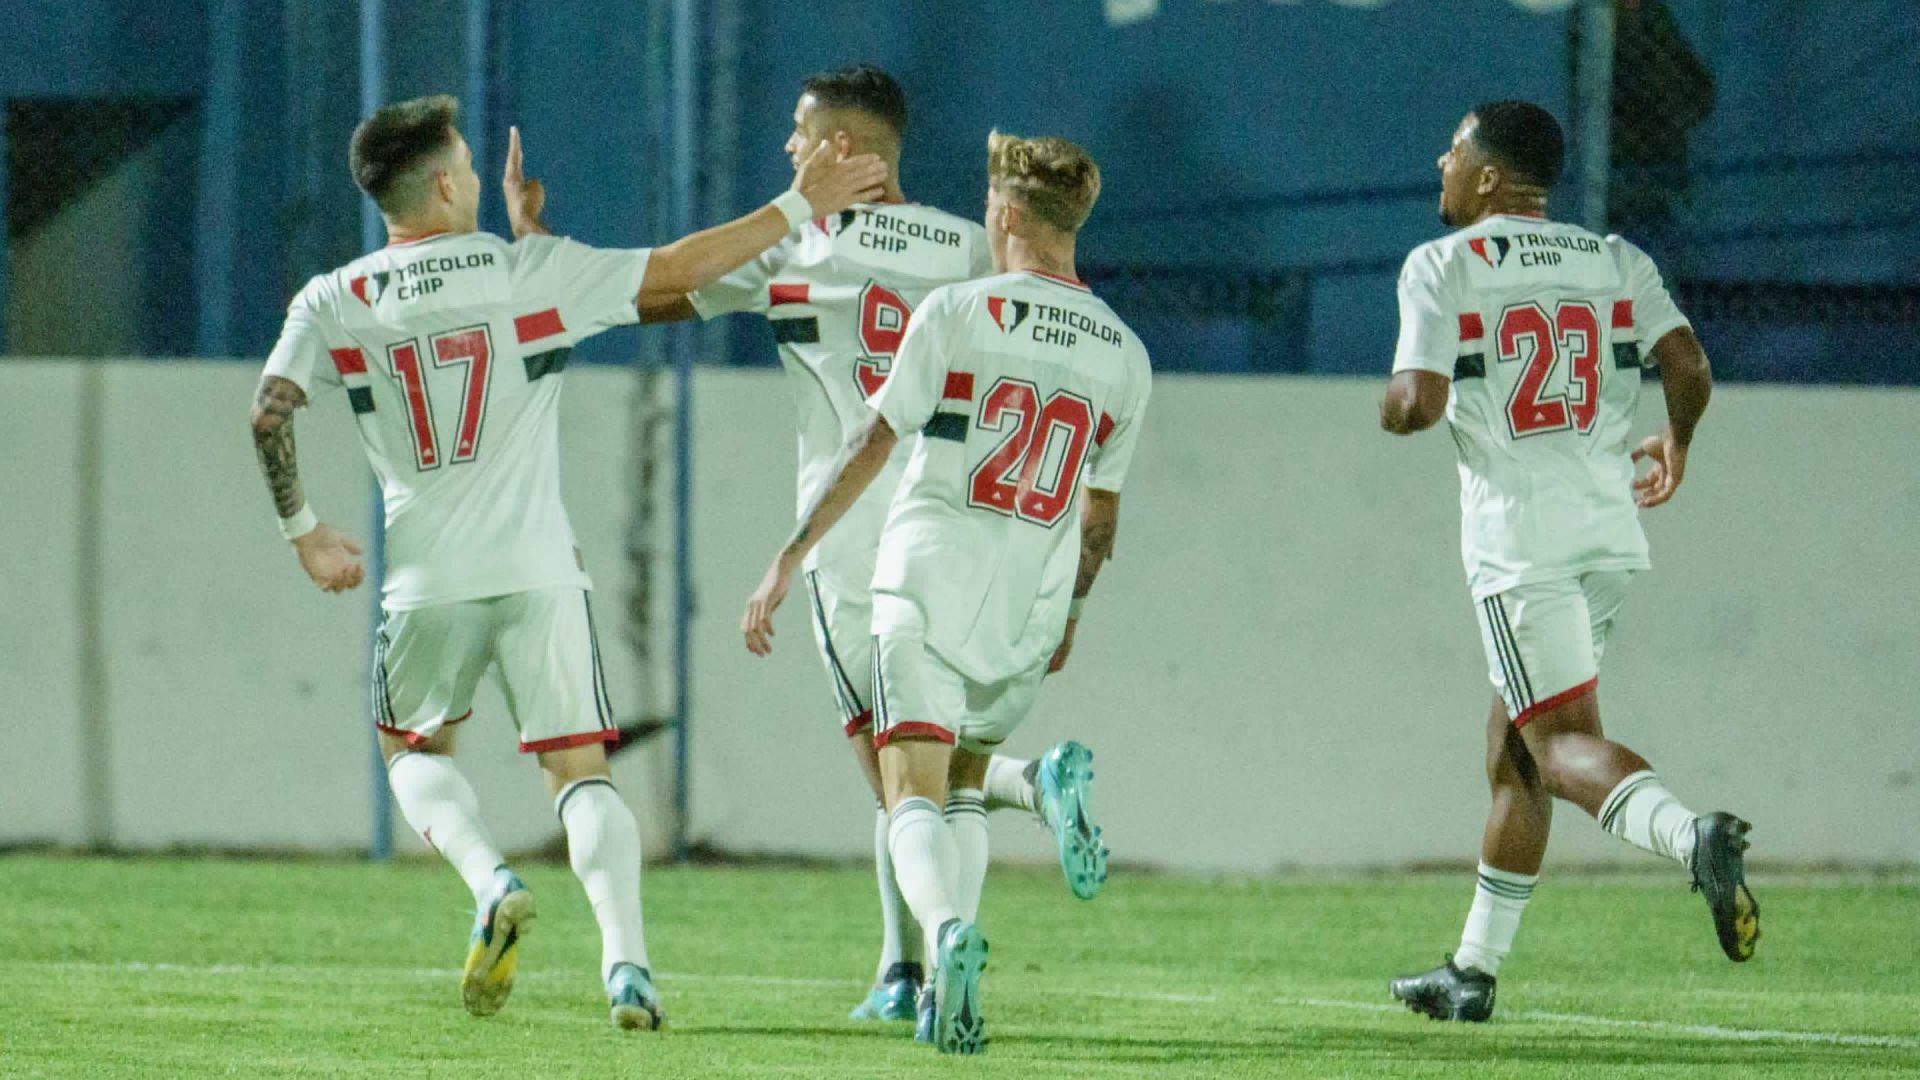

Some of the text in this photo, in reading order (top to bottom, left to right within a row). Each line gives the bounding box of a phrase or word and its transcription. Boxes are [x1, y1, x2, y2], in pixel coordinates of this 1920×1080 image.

[859, 230, 908, 254] CHIP
[861, 209, 962, 248] TRICOLOR
[1512, 232, 1602, 255] TRICOLOR
[395, 252, 496, 283] TRICOLOR
[1519, 251, 1563, 268] CHIP
[397, 276, 445, 301] CHIP
[853, 277, 915, 402] 9
[1031, 325, 1078, 349] CHIP
[1034, 303, 1123, 349] TRICOLOR
[1495, 299, 1603, 440] 23
[385, 322, 495, 473] 17
[966, 375, 1097, 530] 20
